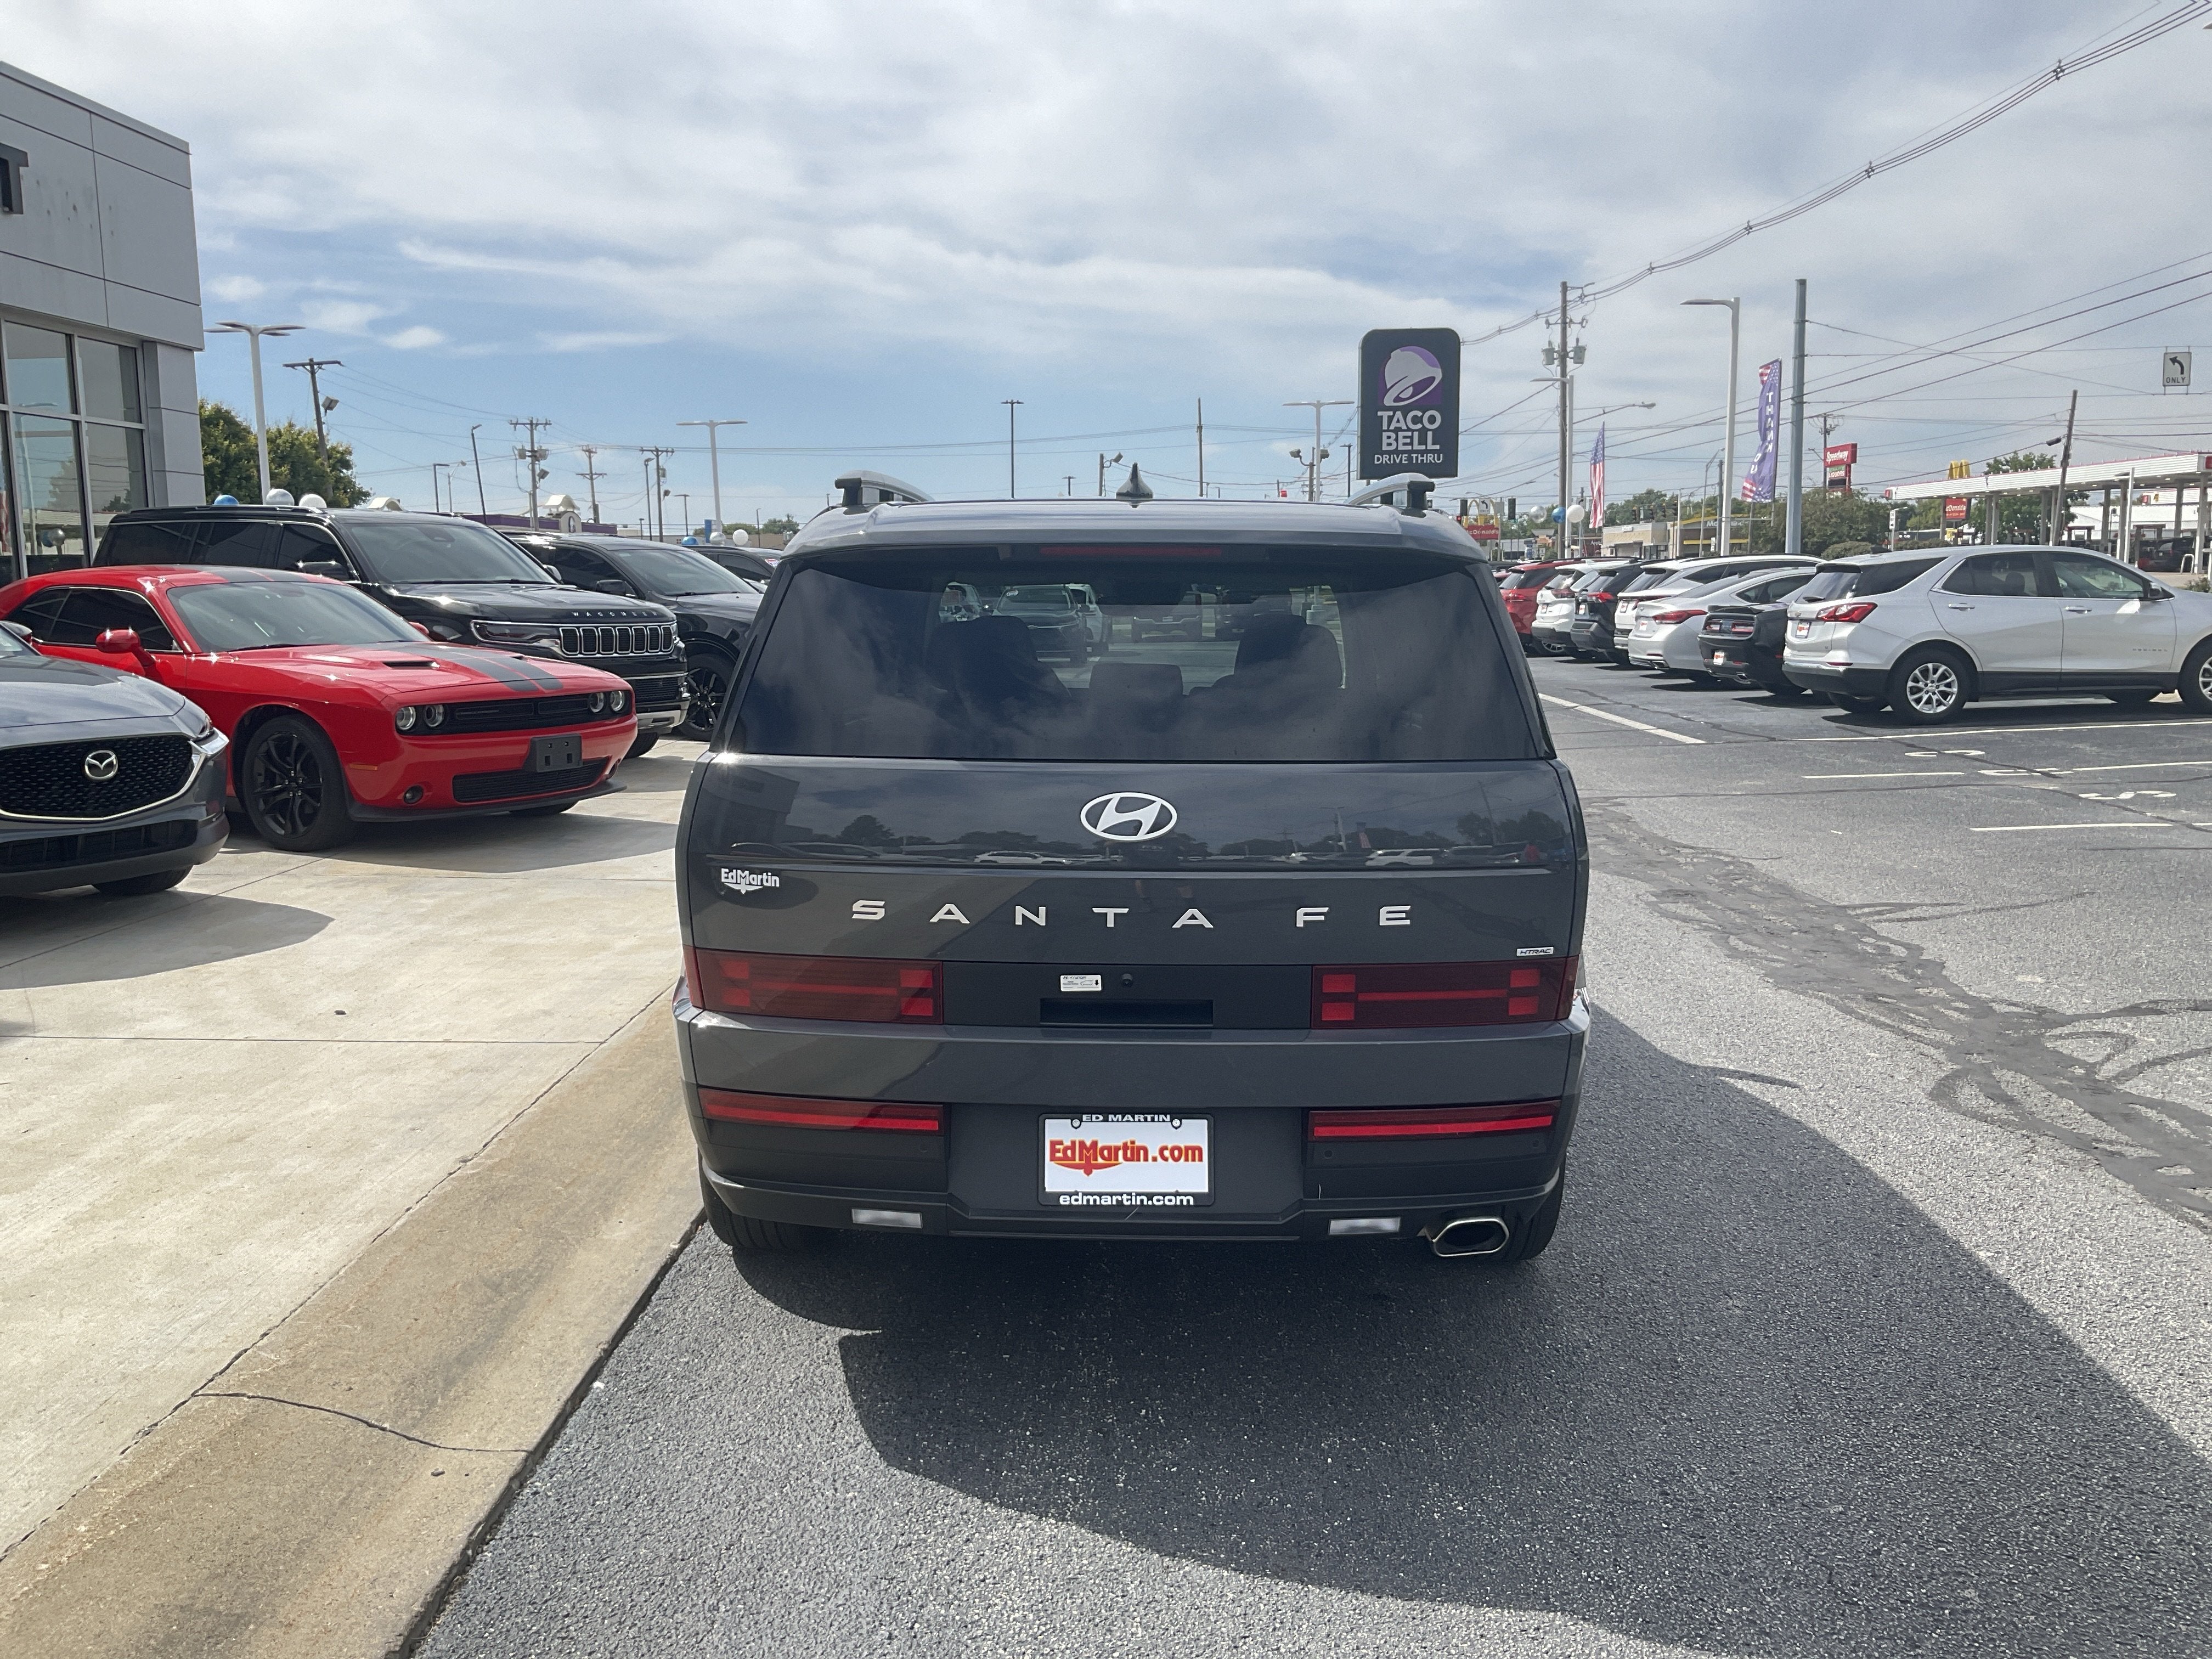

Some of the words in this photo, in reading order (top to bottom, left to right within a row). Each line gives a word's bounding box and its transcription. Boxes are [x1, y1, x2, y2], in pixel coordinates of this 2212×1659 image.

[1377, 410, 1441, 430] TACO
[1382, 431, 1440, 450] BELL
[1374, 454, 1408, 464] DRIVE
[1411, 454, 1443, 463] THRU
[1826, 450, 1849, 465] Speedway
[851, 900, 1214, 928] SANTA
[1296, 905, 1411, 928] FE
[1059, 1192, 1194, 1206] edmartin.com
